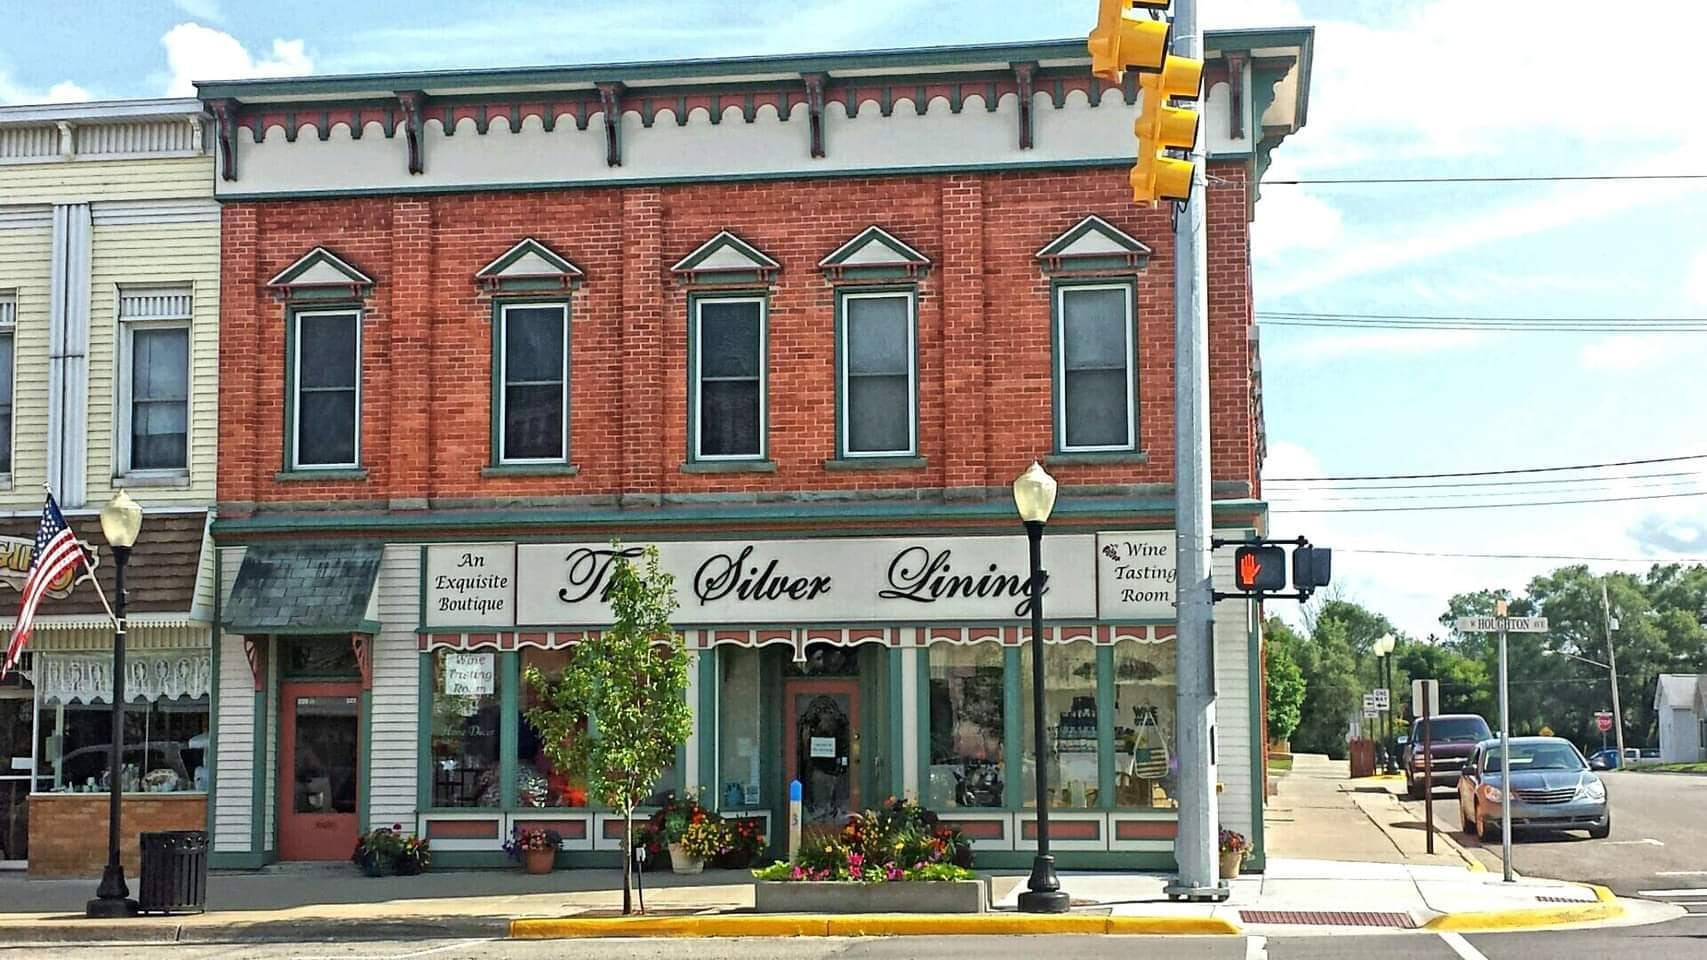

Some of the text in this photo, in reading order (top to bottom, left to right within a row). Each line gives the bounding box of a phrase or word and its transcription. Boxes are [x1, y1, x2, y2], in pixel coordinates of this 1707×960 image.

[1123, 541, 1167, 557] Wine
[457, 553, 485, 567] An
[694, 545, 831, 606] Silver
[878, 546, 1050, 617] Lining
[1114, 563, 1177, 583] Tasting
[435, 574, 508, 593] Exquisite
[1121, 587, 1169, 602] Room
[439, 596, 504, 615] Boutique
[1478, 618, 1530, 630] HOUGHTON
